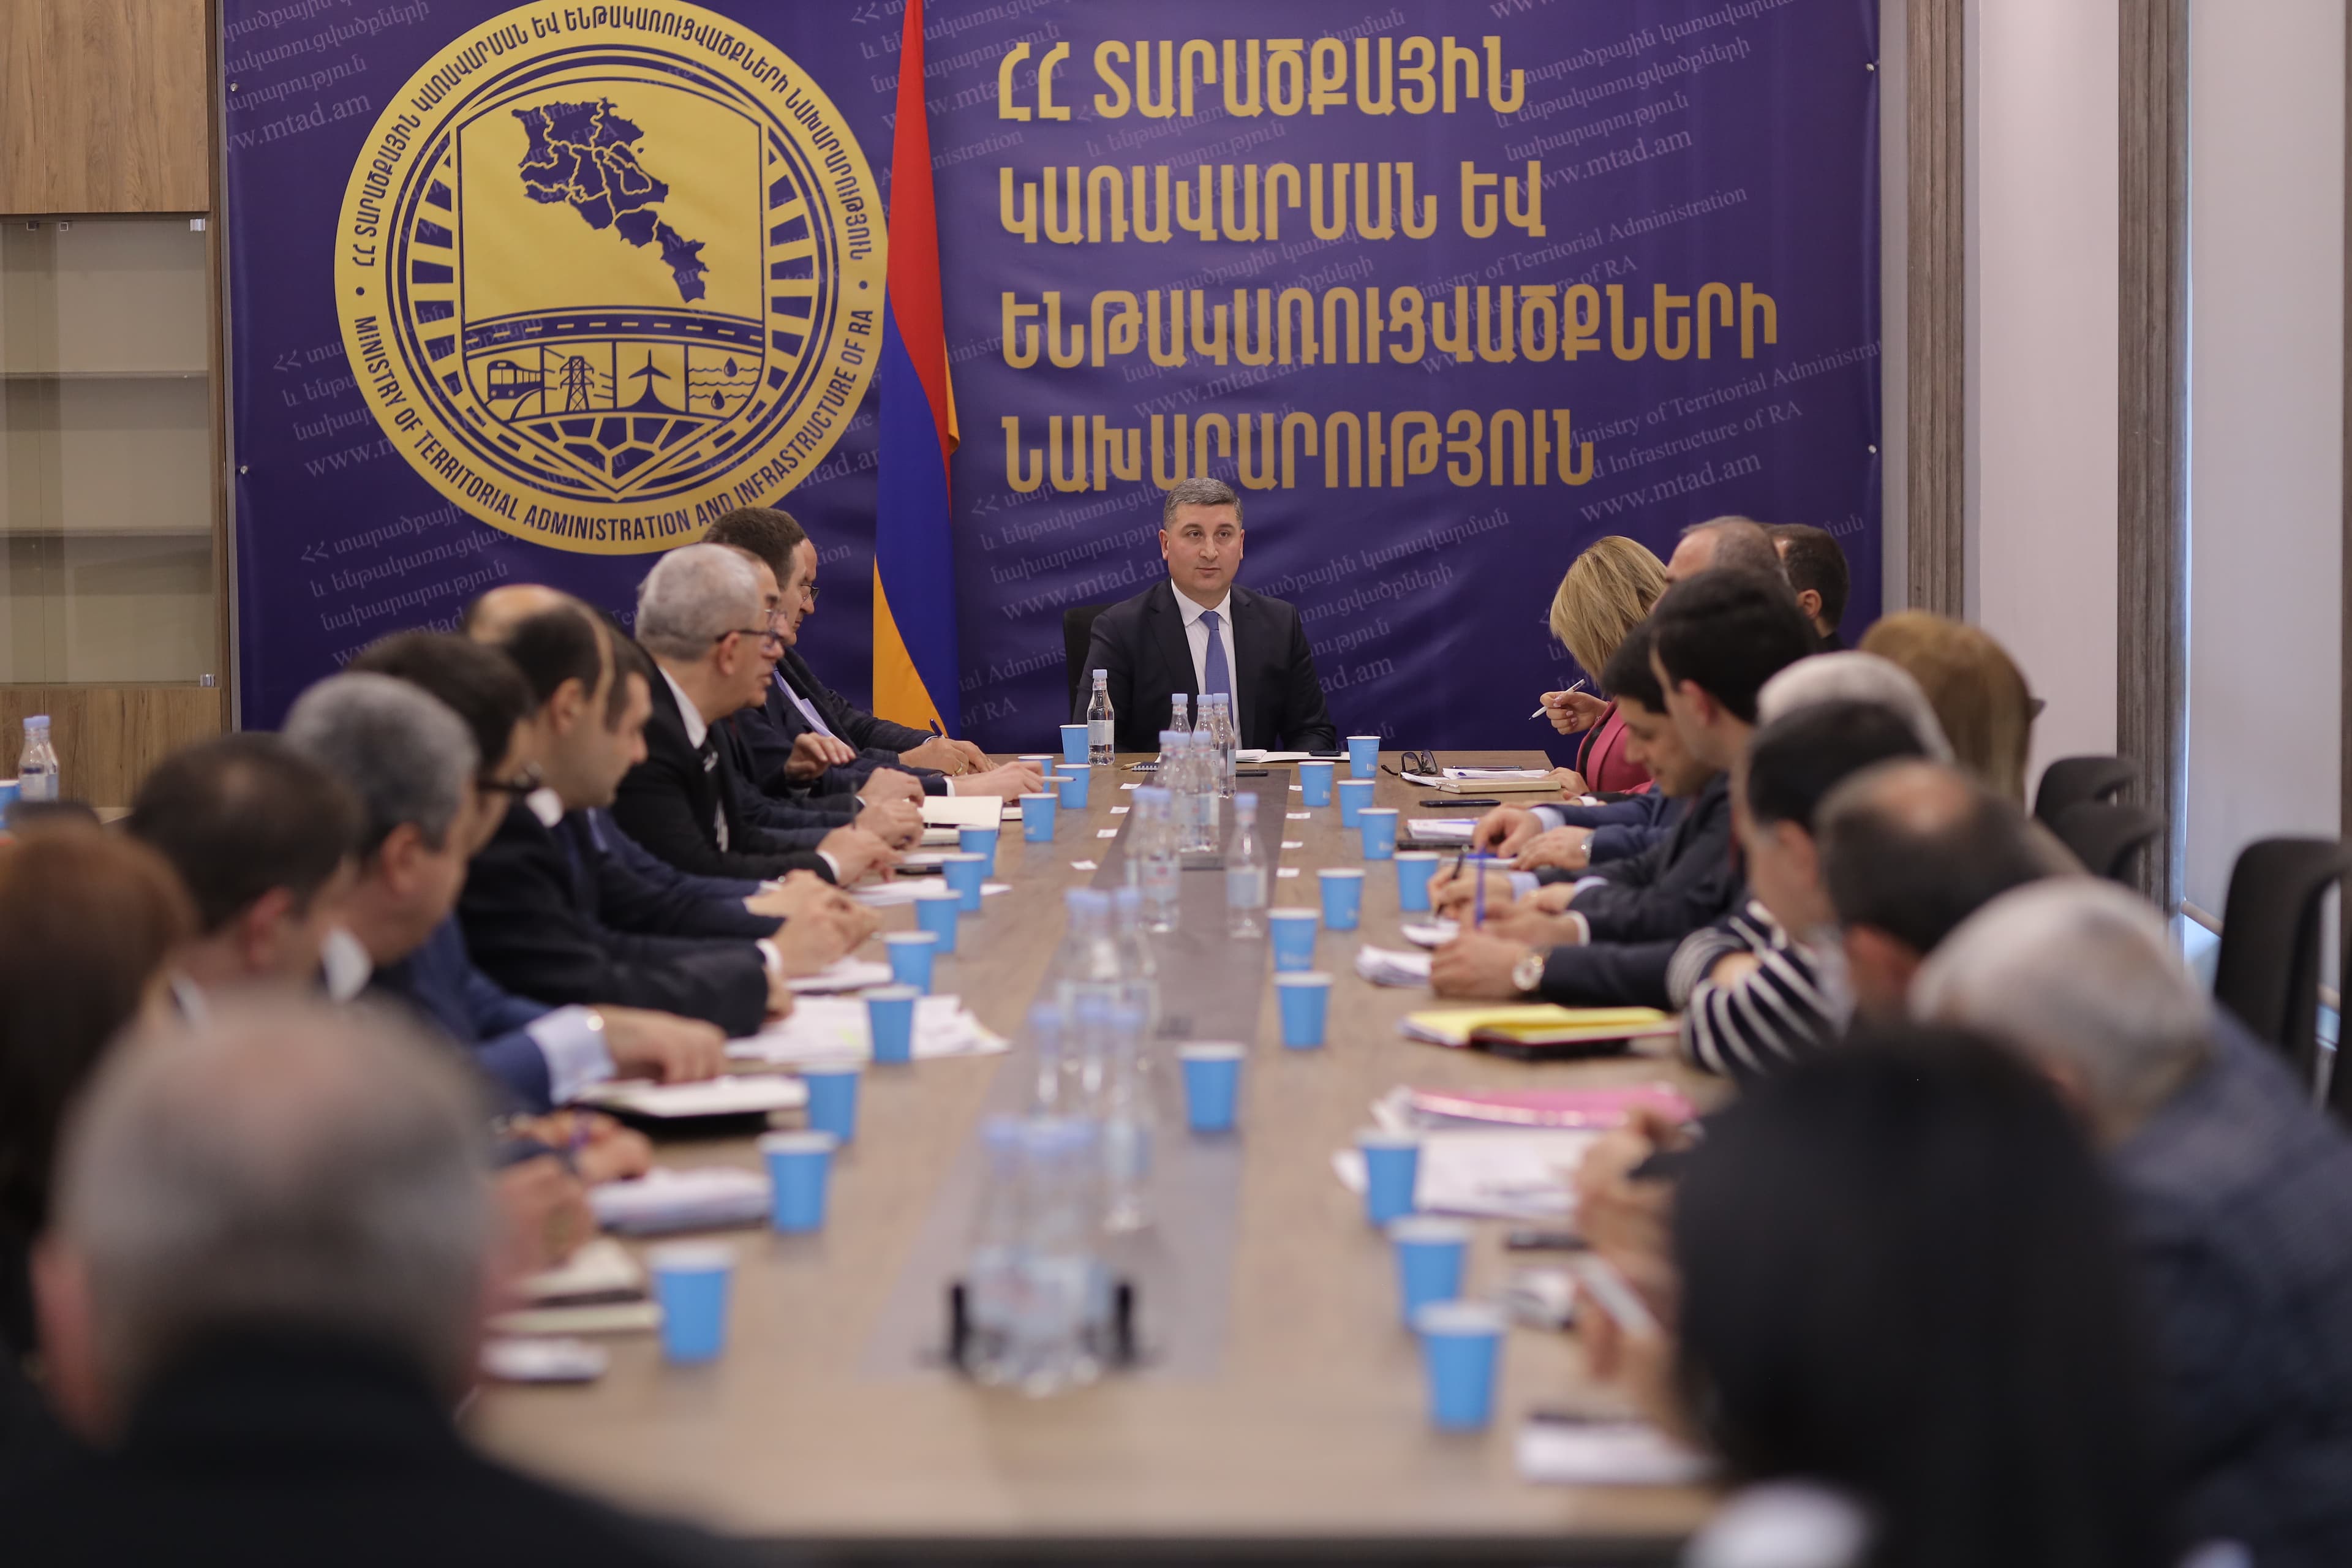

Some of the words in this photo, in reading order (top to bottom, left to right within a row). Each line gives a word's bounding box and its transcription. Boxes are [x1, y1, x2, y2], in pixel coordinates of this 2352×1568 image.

[410, 23, 529, 113] ԿԱՌԱՎԱՐՄԱՆ
[564, 5, 788, 93] ԵՆԹԱԿԱՌՈՒՑՎԱԾՔՆԵՐԻ
[998, 41, 1071, 122] ՀՀ
[1094, 36, 1525, 119] ՏԱՐԱԾՔԱՅԻՆ
[225, 54, 368, 113] արարություն
[1505, 90, 1690, 161] նախարարություն
[355, 113, 421, 238] ՏԱՐԱԾՔԱՅԻՆ
[785, 87, 873, 262] ՆԱԽԱՐԱՐՈՒԹՅՈՒՆ
[1000, 162, 1438, 244] ԿԱՌԱՎԱՐՄԱՆ
[352, 243, 376, 267] ՀՀ
[1485, 258, 1506, 280] of
[1507, 227, 1604, 273] Territorial
[1606, 186, 1748, 246] Administration
[1604, 254, 1638, 279] RA
[840, 338, 867, 366] OF
[848, 310, 873, 336] RA
[1001, 282, 1777, 369] ԵՆԹԱԿԱՌՈՒՑՎԱԾՔՆԵՐԻ
[272, 349, 302, 373] ՀՀ
[354, 315, 407, 407] MINISTRY
[394, 408, 423, 433] OF
[1646, 402, 1667, 426] of
[1667, 372, 1768, 418] Territorial
[735, 366, 857, 506] INFRASTRUCTURE
[1001, 409, 1594, 493] ՆԱԽԱՐԱՐՈՒԹՅՈՒՆ
[1608, 419, 1738, 476] Infrastructure
[1744, 407, 1765, 432] of
[1767, 399, 1803, 425] RA
[413, 428, 519, 521] TERRITORIAL
[971, 495, 1000, 517] ՀՀ
[1579, 452, 1762, 523] www.mtad.am
[300, 541, 330, 564] ՀՀ
[334, 501, 468, 556] տարածքայի
[522, 504, 691, 541] ADMINISTRATION
[696, 493, 735, 527] AND
[1360, 506, 1510, 567] կառավարման
[320, 560, 509, 631] նախարարություն
[1299, 562, 1454, 624] ռուցվածքների
[989, 644, 1067, 685] Adminis
[1310, 617, 1392, 657] ություն
[984, 695, 1020, 722] RA
